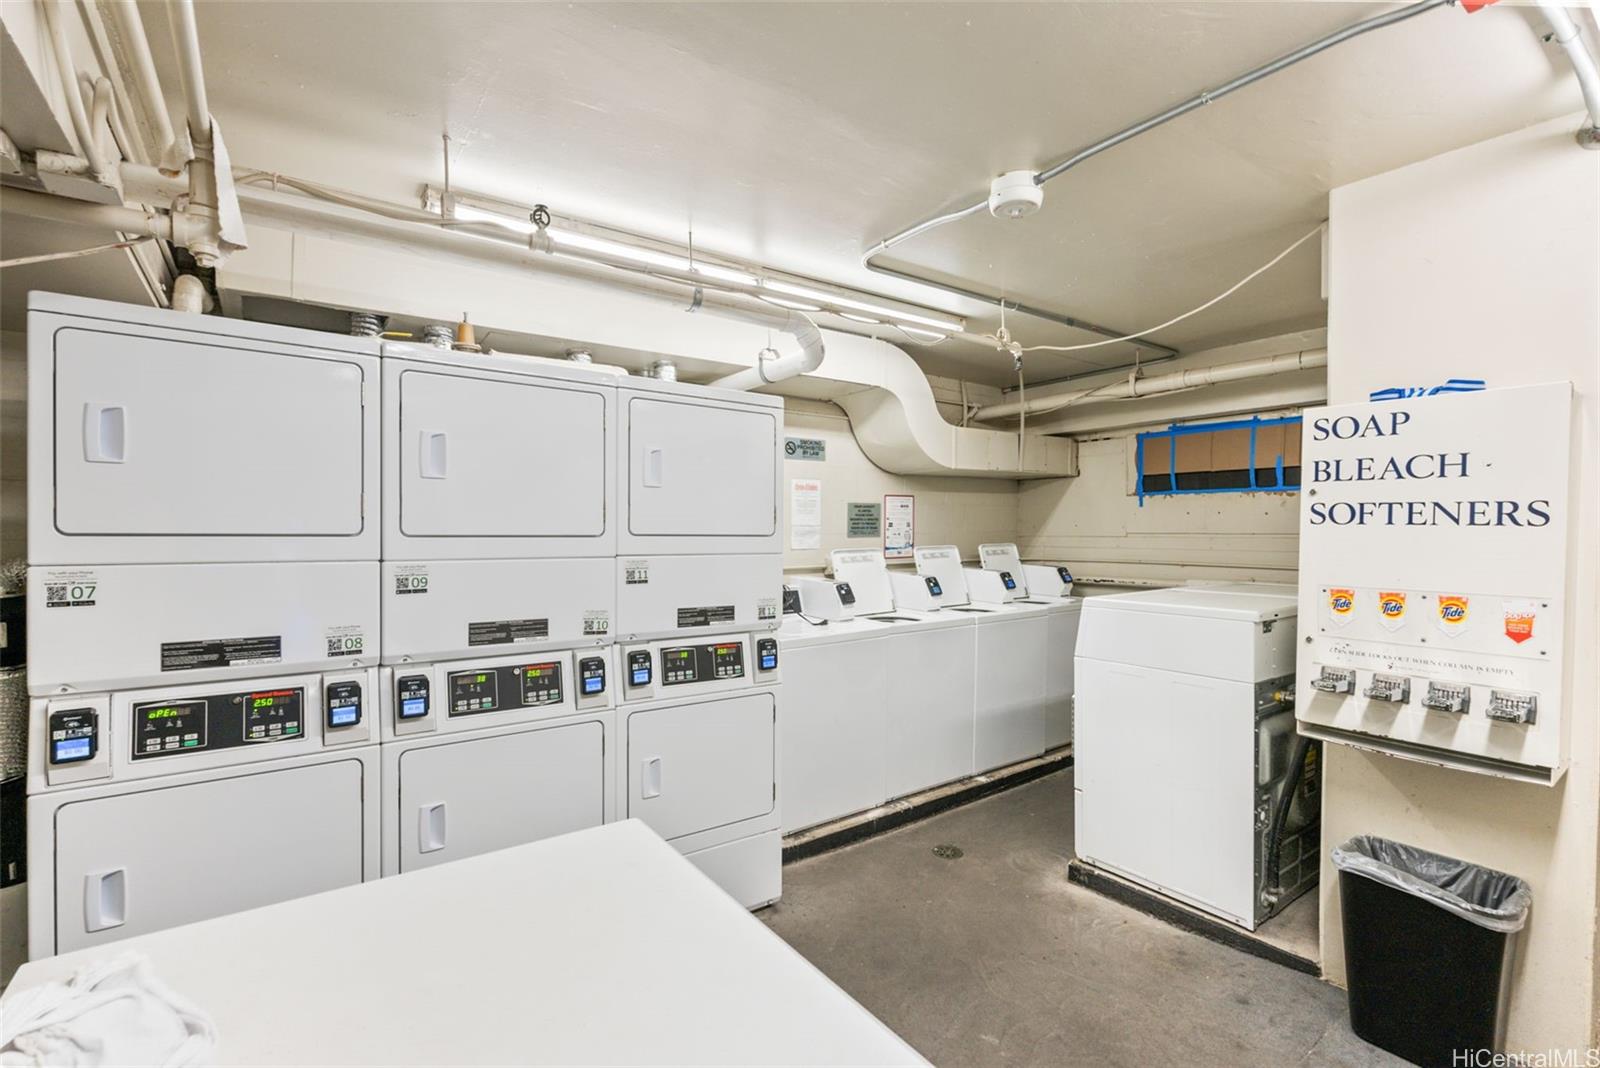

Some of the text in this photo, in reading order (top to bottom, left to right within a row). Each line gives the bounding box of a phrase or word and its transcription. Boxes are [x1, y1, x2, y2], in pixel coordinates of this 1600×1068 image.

[1313, 411, 1410, 441] SOAP
[1312, 452, 1470, 483] BLEACH
[1310, 500, 1550, 527] SOFTENERS
[637, 570, 648, 580] 11
[411, 577, 428, 588] 09
[72, 586, 96, 600] 07
[1332, 598, 1352, 610] Tide
[1381, 601, 1403, 613] Tide
[767, 607, 776, 616] 12
[1441, 606, 1465, 619] Tide
[596, 620, 608, 630] 10
[344, 637, 364, 650] 08
